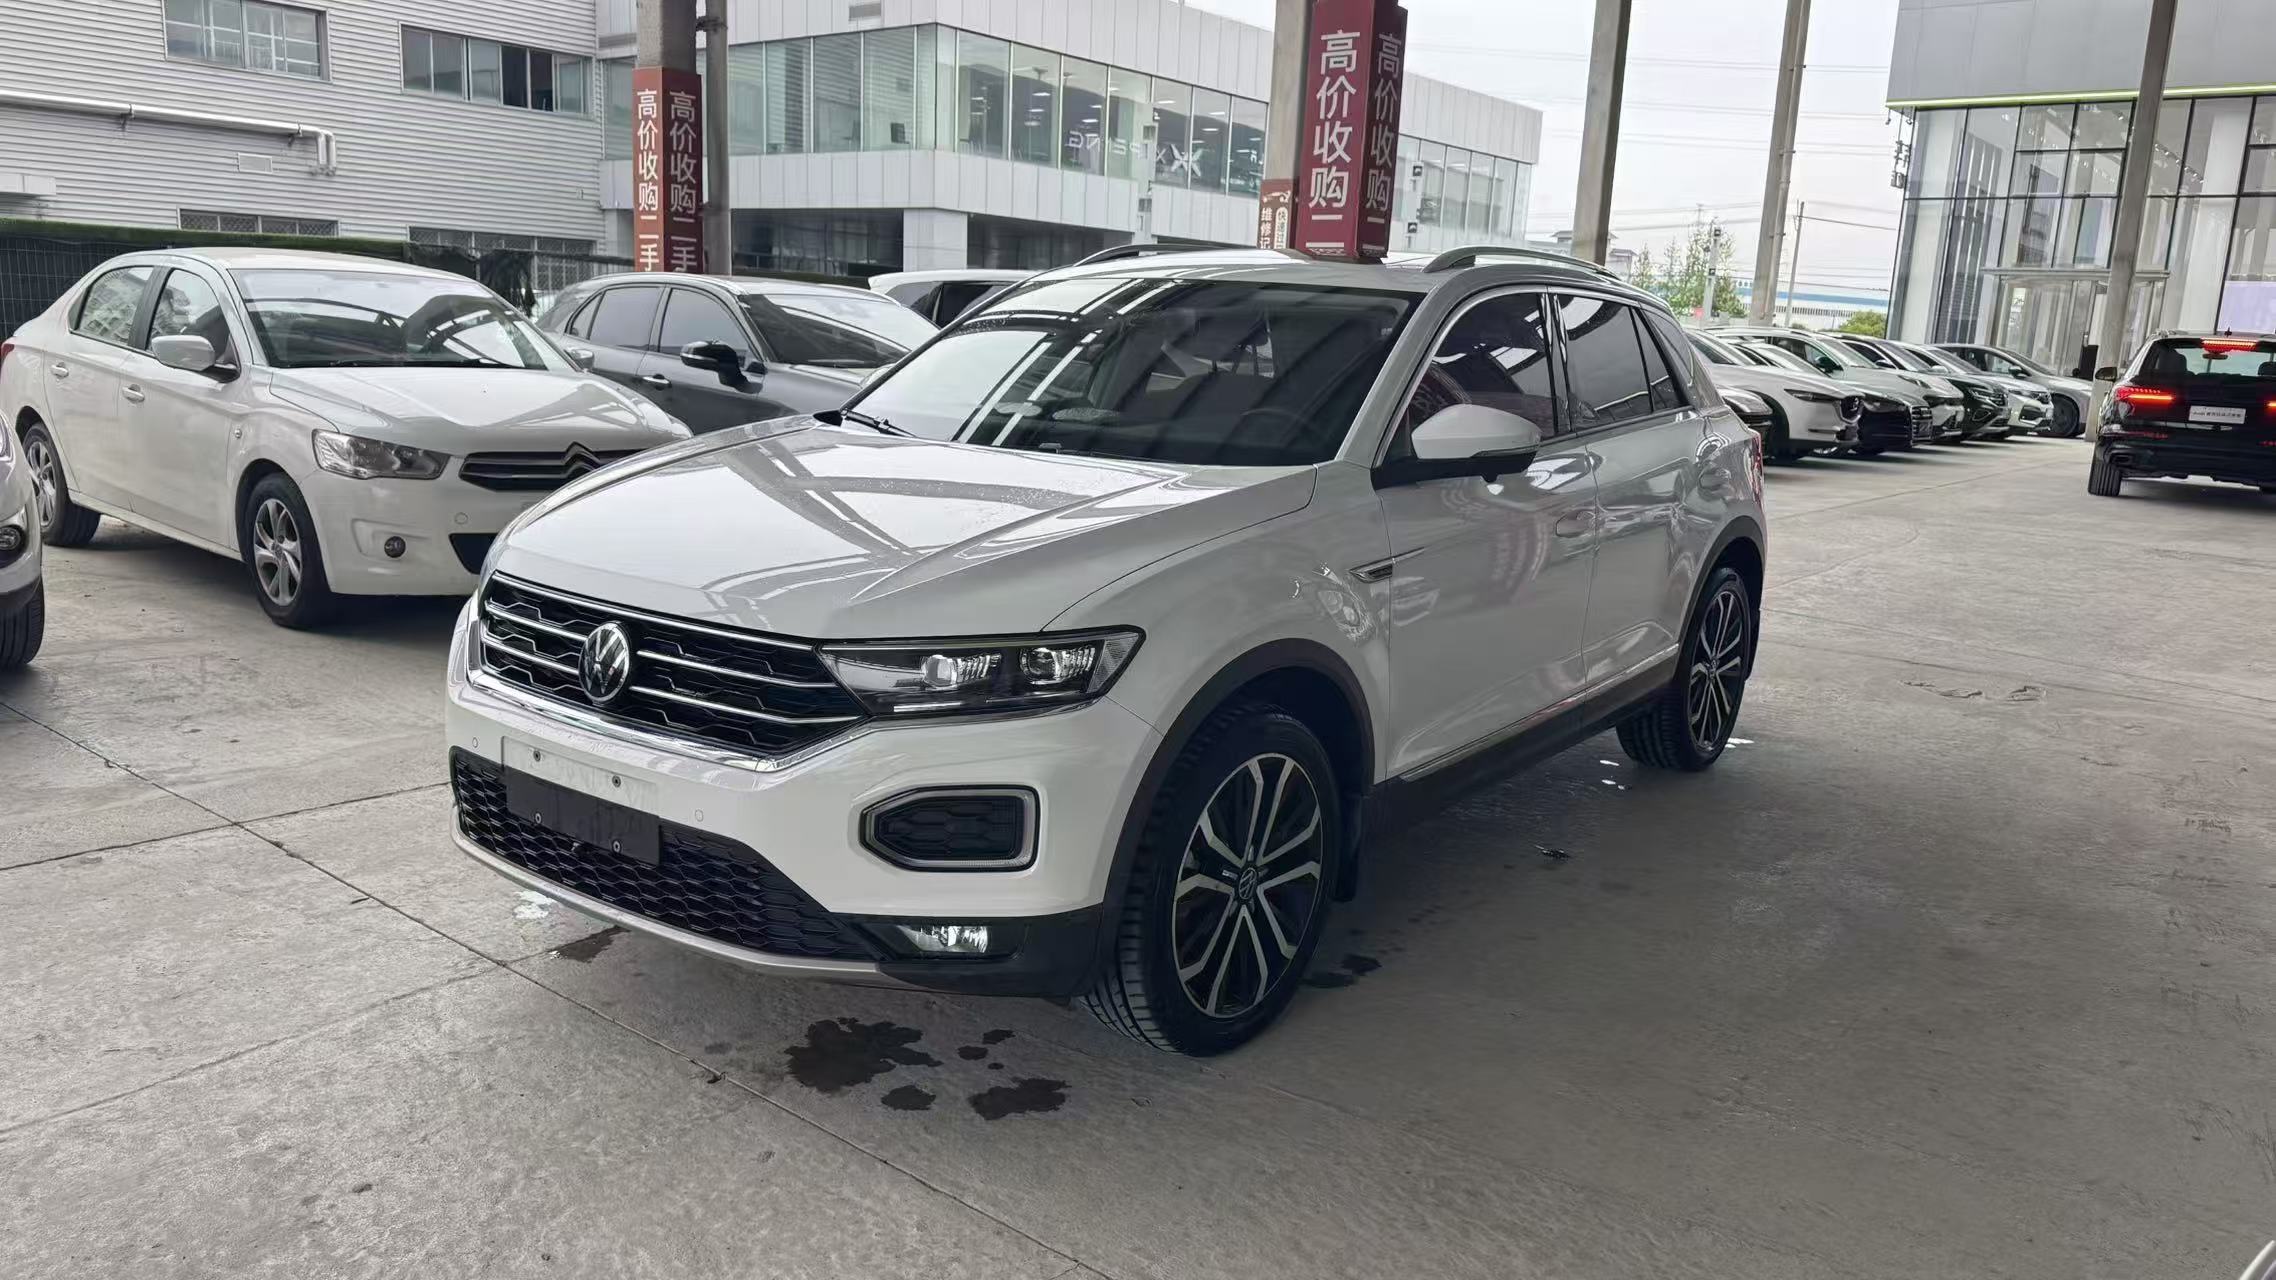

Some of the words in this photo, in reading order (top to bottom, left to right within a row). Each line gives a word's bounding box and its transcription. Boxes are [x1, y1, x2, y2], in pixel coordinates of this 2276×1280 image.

[637, 89, 659, 272] 高价收购二手
[669, 91, 697, 272] 高价收购二手
[1305, 29, 1360, 256] 高价收购二
[1362, 33, 1401, 255] 高价收购二
